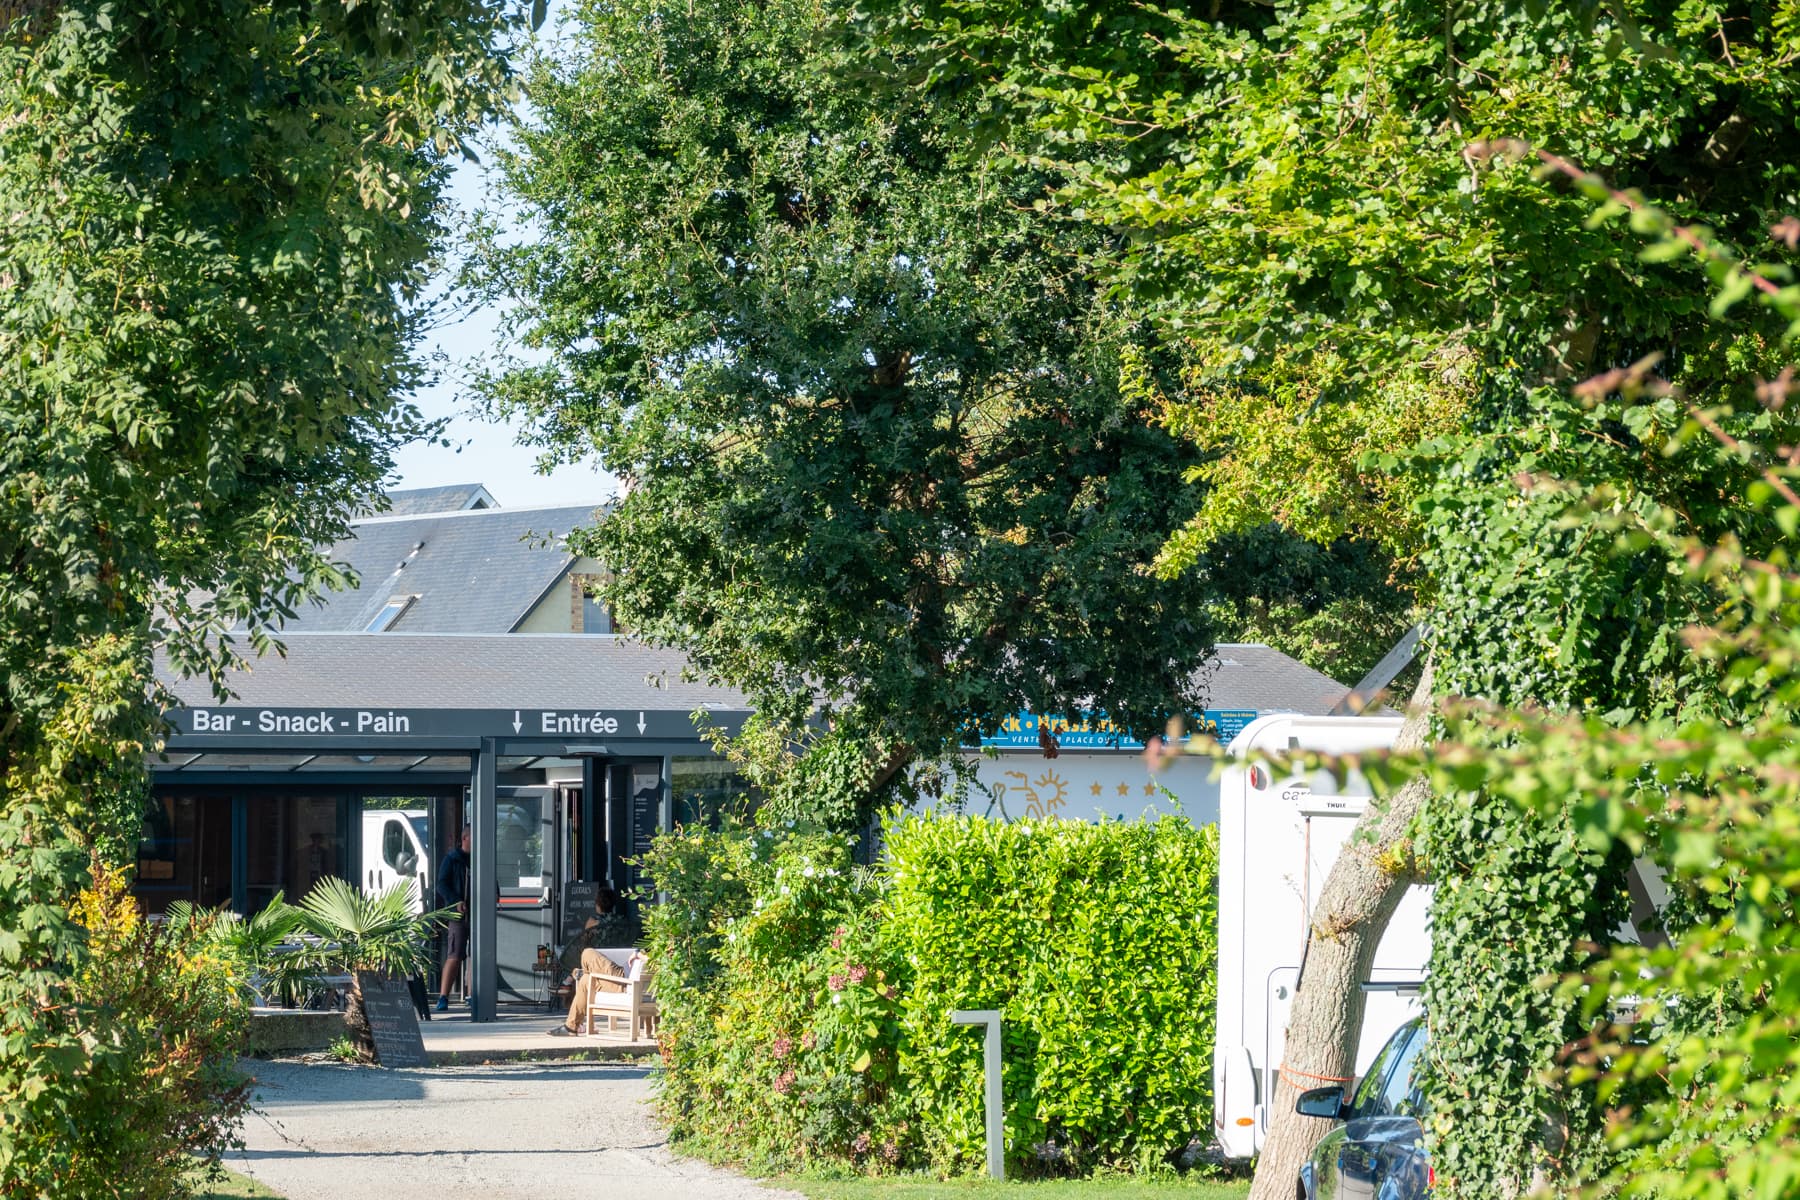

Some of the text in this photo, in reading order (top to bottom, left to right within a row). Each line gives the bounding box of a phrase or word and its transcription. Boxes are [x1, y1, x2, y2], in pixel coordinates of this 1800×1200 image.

[193, 710, 235, 731] Bar
[258, 710, 334, 732] Snack
[357, 711, 409, 732] Pain
[541, 712, 618, 733] Entrée
[1065, 736, 1094, 744] PLACE
